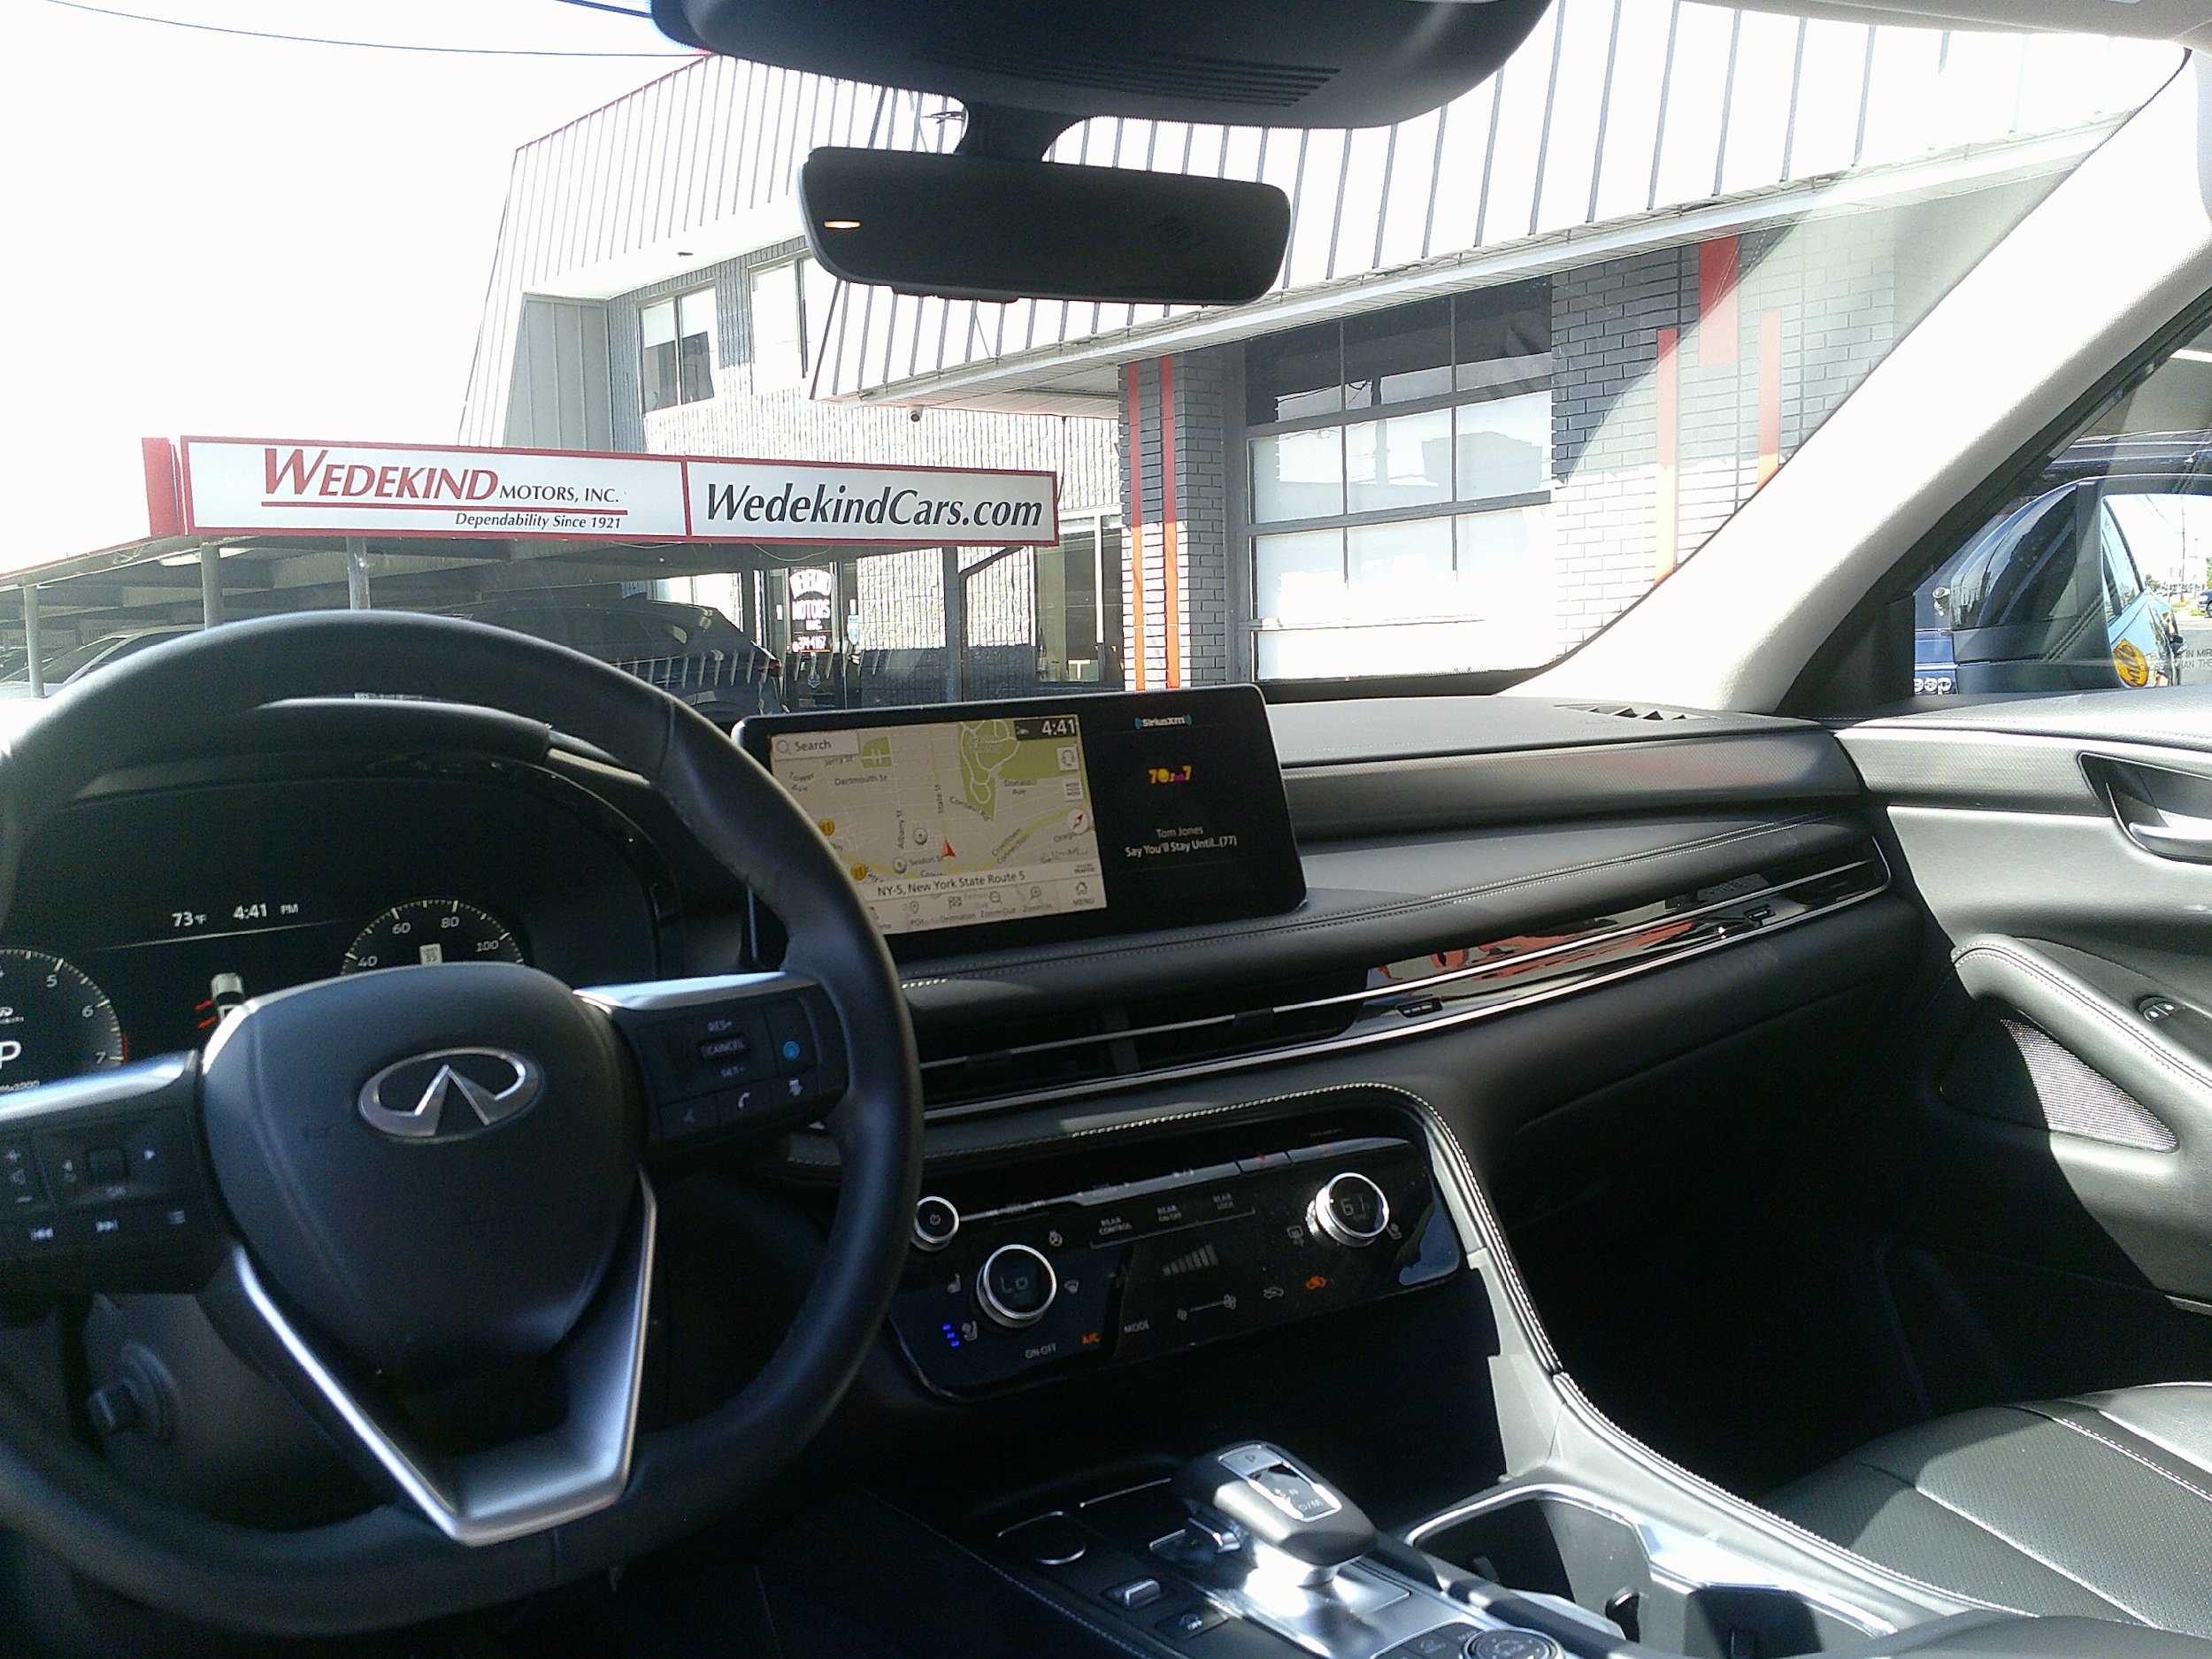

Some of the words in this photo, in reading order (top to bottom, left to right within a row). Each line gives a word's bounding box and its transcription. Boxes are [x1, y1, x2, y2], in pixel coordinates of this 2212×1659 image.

[265, 449, 499, 500] WEDEKIND
[499, 485, 580, 504] MOTORS,
[585, 487, 619, 503] INC.
[707, 481, 1044, 527] WedekindCars.com
[455, 512, 549, 531] Dependability
[552, 514, 588, 529] Since
[590, 516, 620, 530] 1921
[1041, 719, 1076, 736] 4:41
[795, 739, 832, 752] Search
[1156, 827, 1177, 839] Tom
[1178, 826, 1204, 837] Jones
[1125, 845, 1143, 859] Say
[1143, 841, 1170, 855] You'll
[1170, 841, 1191, 854] Stay
[878, 885, 907, 897] NY-5,
[909, 881, 933, 893] New
[933, 877, 956, 890] York
[958, 875, 986, 887] State
[987, 872, 1016, 886] Route
[1018, 872, 1025, 882] 5
[233, 902, 268, 920] 4:41
[280, 903, 299, 915] PM
[391, 922, 411, 934] 60
[441, 916, 460, 929] 80
[475, 940, 500, 952] 100
[357, 956, 379, 967] 40
[46, 974, 58, 987] 5
[81, 1004, 95, 1018] 6
[0, 1040, 23, 1071] P
[96, 1050, 107, 1065] 7
